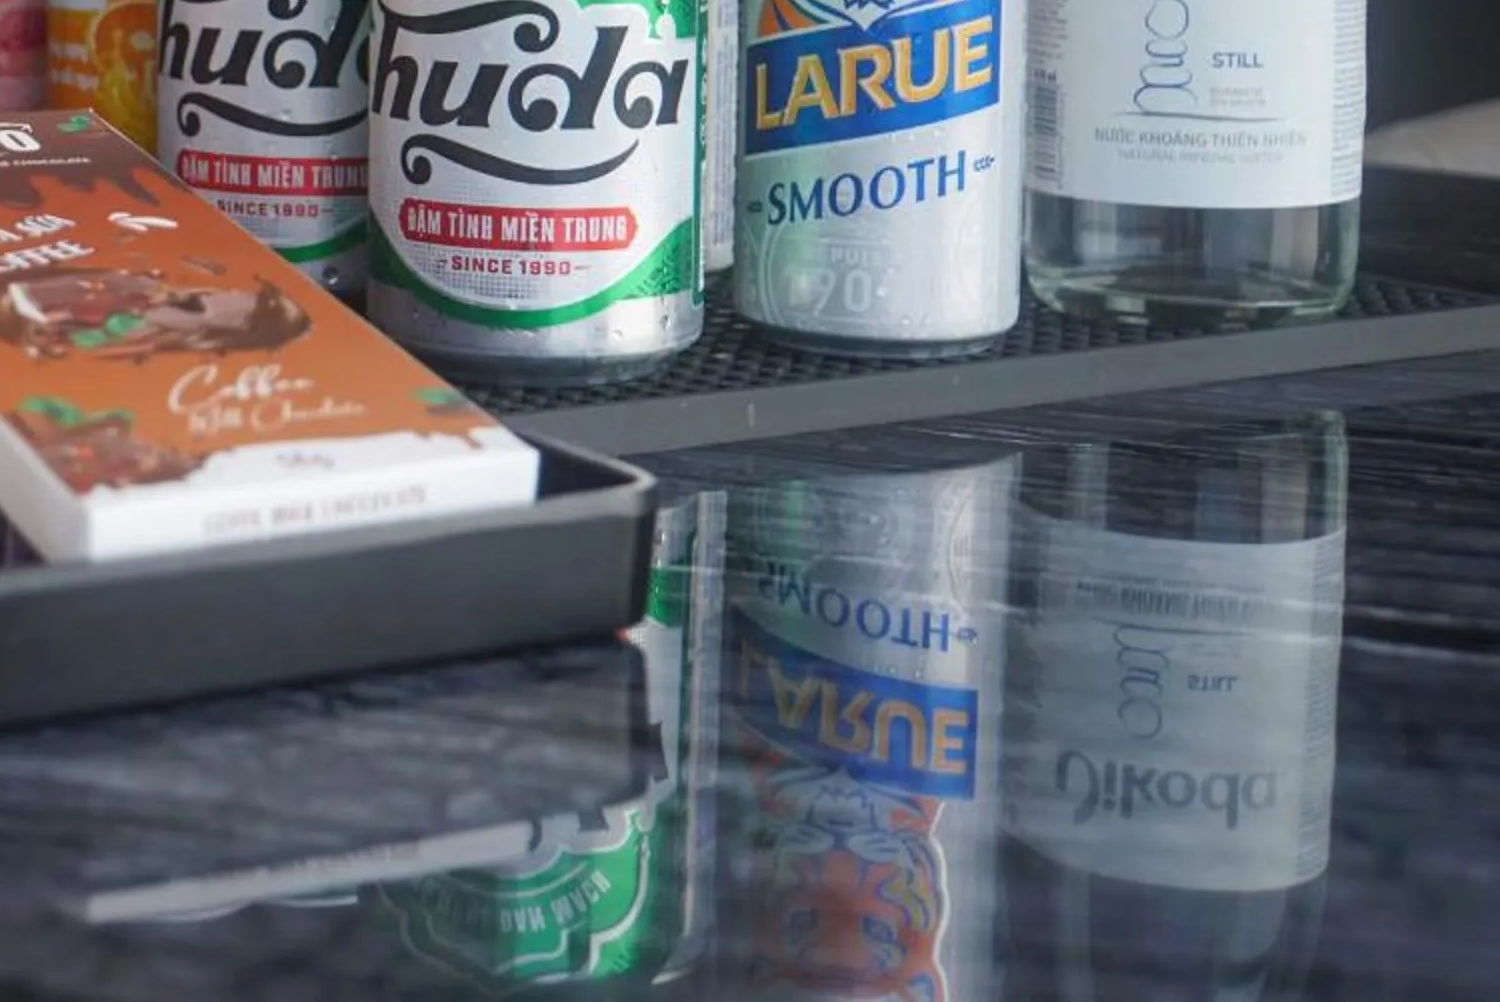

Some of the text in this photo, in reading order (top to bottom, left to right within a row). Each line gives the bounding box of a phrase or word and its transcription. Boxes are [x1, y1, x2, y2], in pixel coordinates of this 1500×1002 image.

[755, 15, 994, 132] LARUE
[1211, 52, 1264, 69] STILL
[767, 150, 967, 226] SMOOTH
[447, 206, 493, 241] TÌNH
[563, 216, 628, 244] TRUNG
[451, 255, 573, 276] SINCE 1990
[167, 364, 318, 415] Coffee
